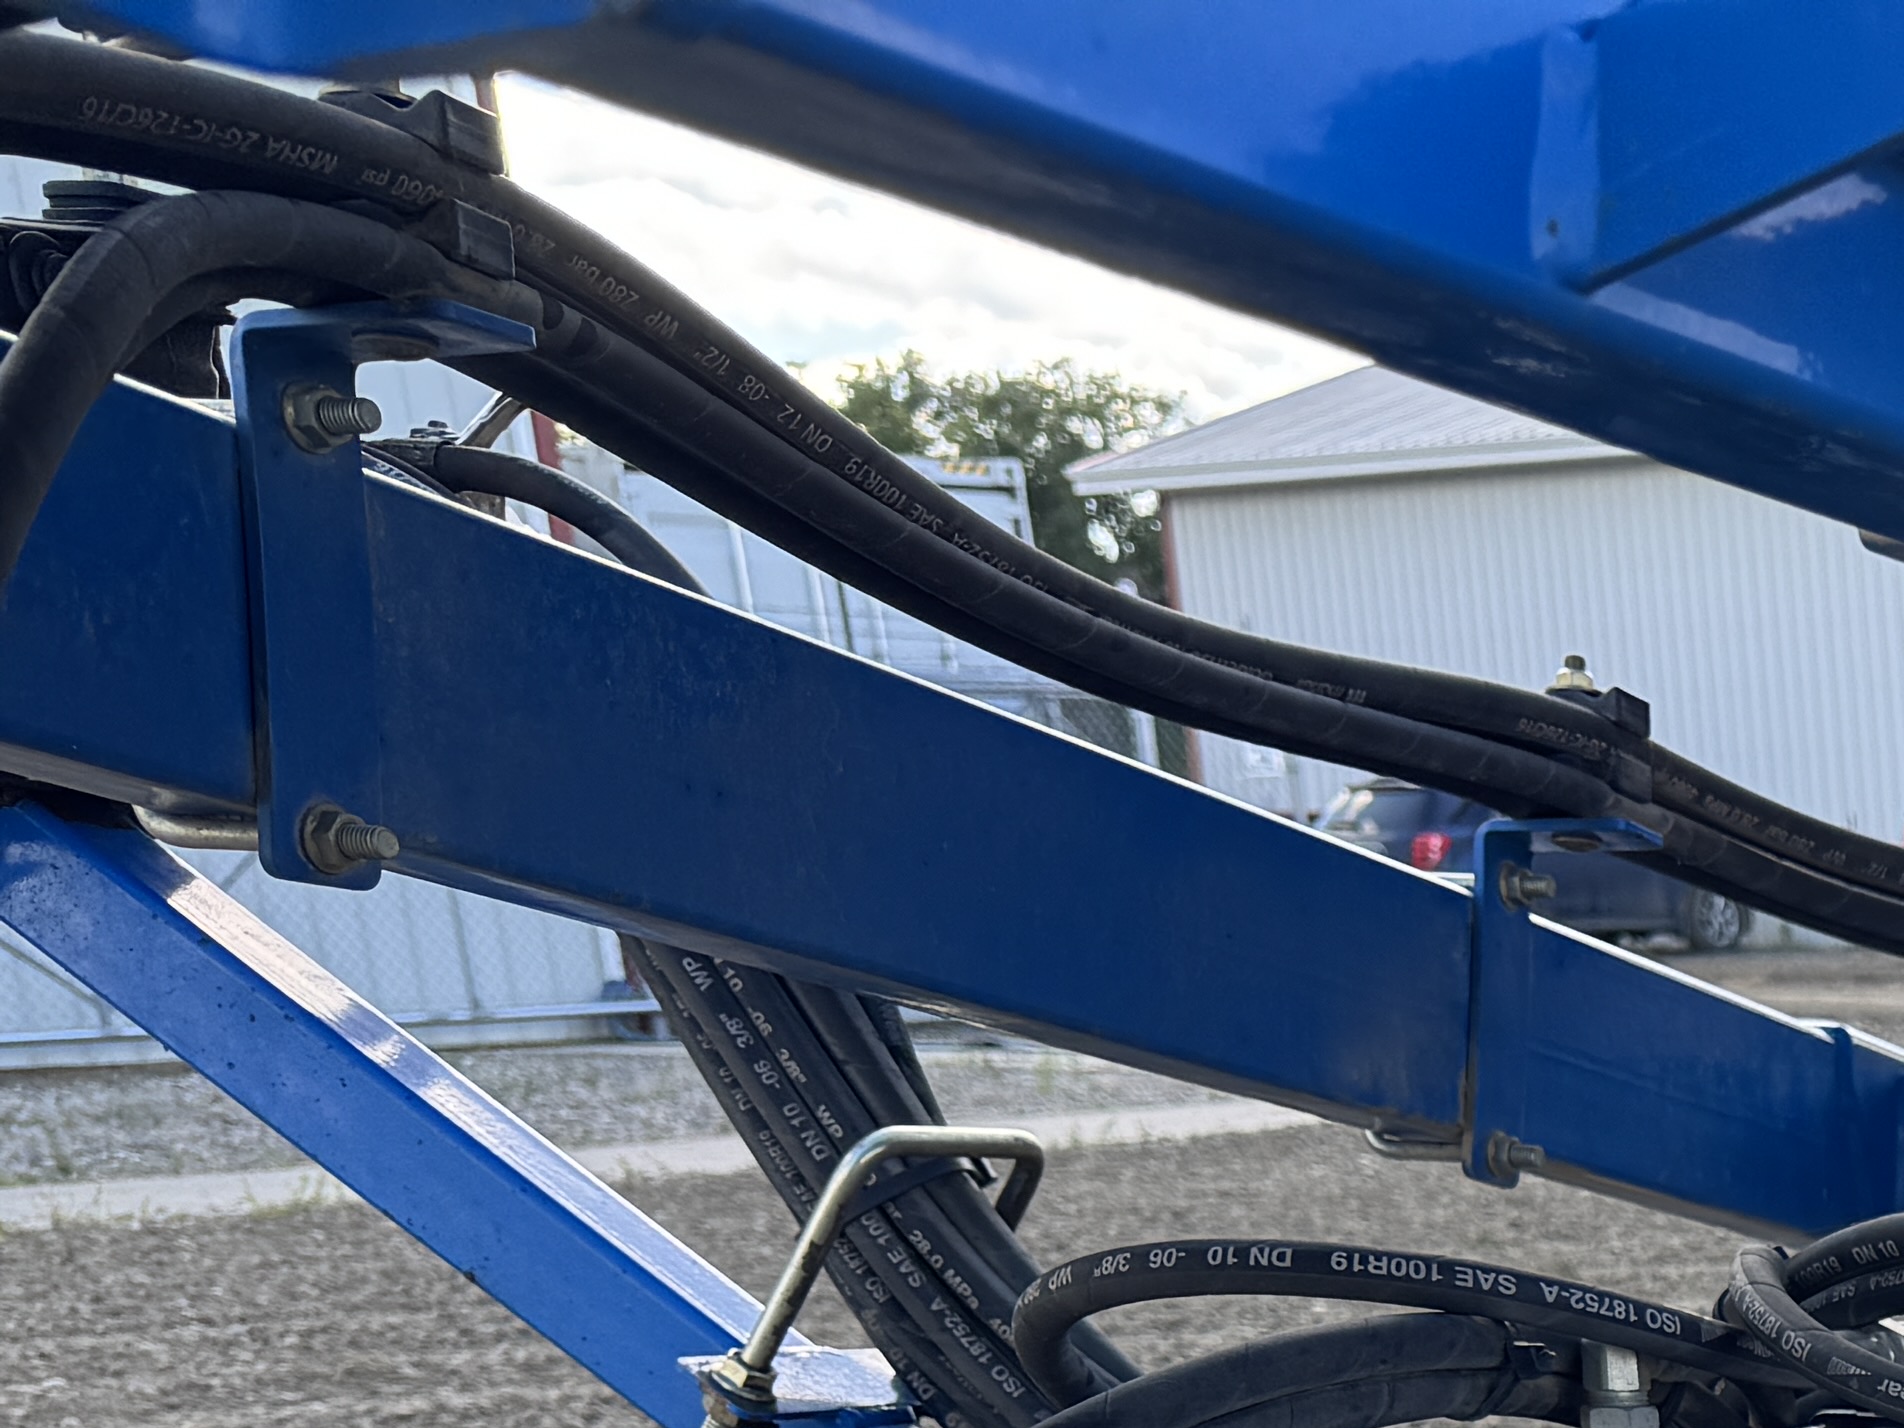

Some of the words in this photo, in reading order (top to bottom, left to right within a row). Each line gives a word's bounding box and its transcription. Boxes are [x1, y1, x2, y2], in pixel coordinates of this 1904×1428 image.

[81, 95, 251, 155] 2G-IC-126C/16
[263, 135, 339, 175] MSHA
[570, 253, 601, 282] bar
[599, 276, 640, 312] 280
[645, 309, 681, 339] WP
[737, 373, 771, 403] -08
[776, 402, 803, 431] 12
[802, 425, 834, 454] DN
[681, 956, 715, 992] WP
[718, 1012, 755, 1049] 3/8"
[752, 1059, 782, 1090] -06
[781, 1102, 806, 1128] 10
[800, 1129, 831, 1162] DN
[886, 1246, 927, 1289] SAE
[1091, 1252, 1132, 1280] 3/8"
[1148, 1247, 1187, 1270] -06
[1206, 1245, 1240, 1267] 10
[1247, 1245, 1294, 1268] DN
[1330, 1250, 1444, 1282] 100R19
[1852, 1245, 1877, 1265] DN
[1878, 1239, 1900, 1258] 10
[942, 1267, 980, 1311] MPa
[1046, 1264, 1073, 1292] WP
[1453, 1265, 1518, 1297] SAE
[1538, 1280, 1640, 1323] 18752-A
[1741, 1293, 1783, 1339] 18752-A
[928, 1295, 995, 1365] 18752-A
[1644, 1310, 1682, 1336] ISO
[1780, 1329, 1813, 1363] ISO
[990, 1364, 1028, 1399] ISO
